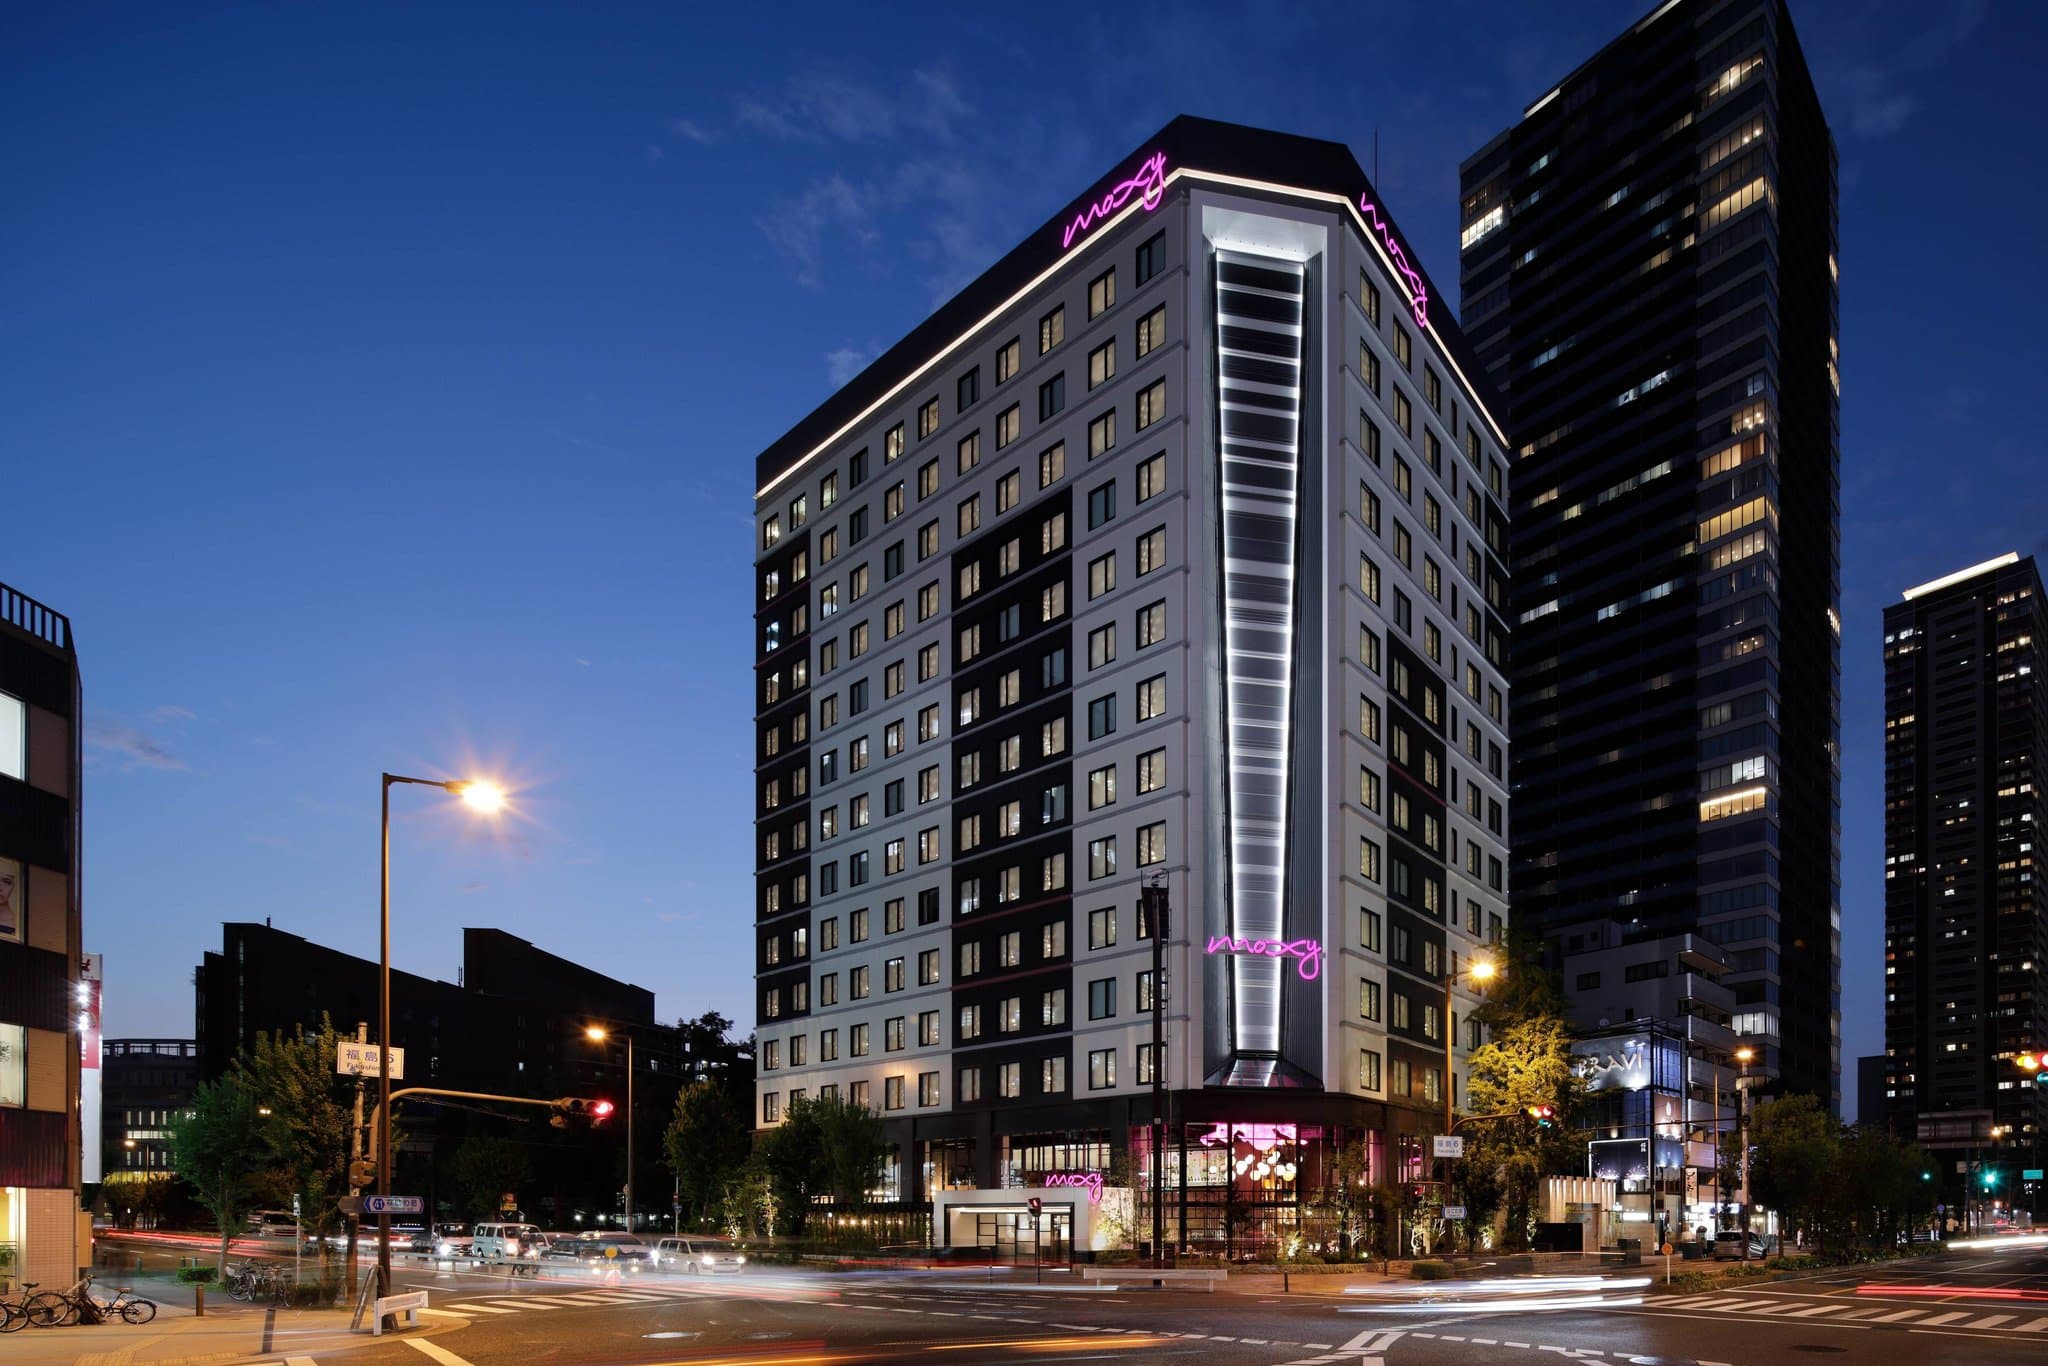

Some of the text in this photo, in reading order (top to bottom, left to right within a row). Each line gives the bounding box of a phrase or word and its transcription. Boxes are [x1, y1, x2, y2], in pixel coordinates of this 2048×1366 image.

[1063, 151, 1167, 248] moxy
[1360, 191, 1428, 328] moxy
[1207, 935, 1322, 980] moxy
[1045, 1173, 1103, 1204] moxy
